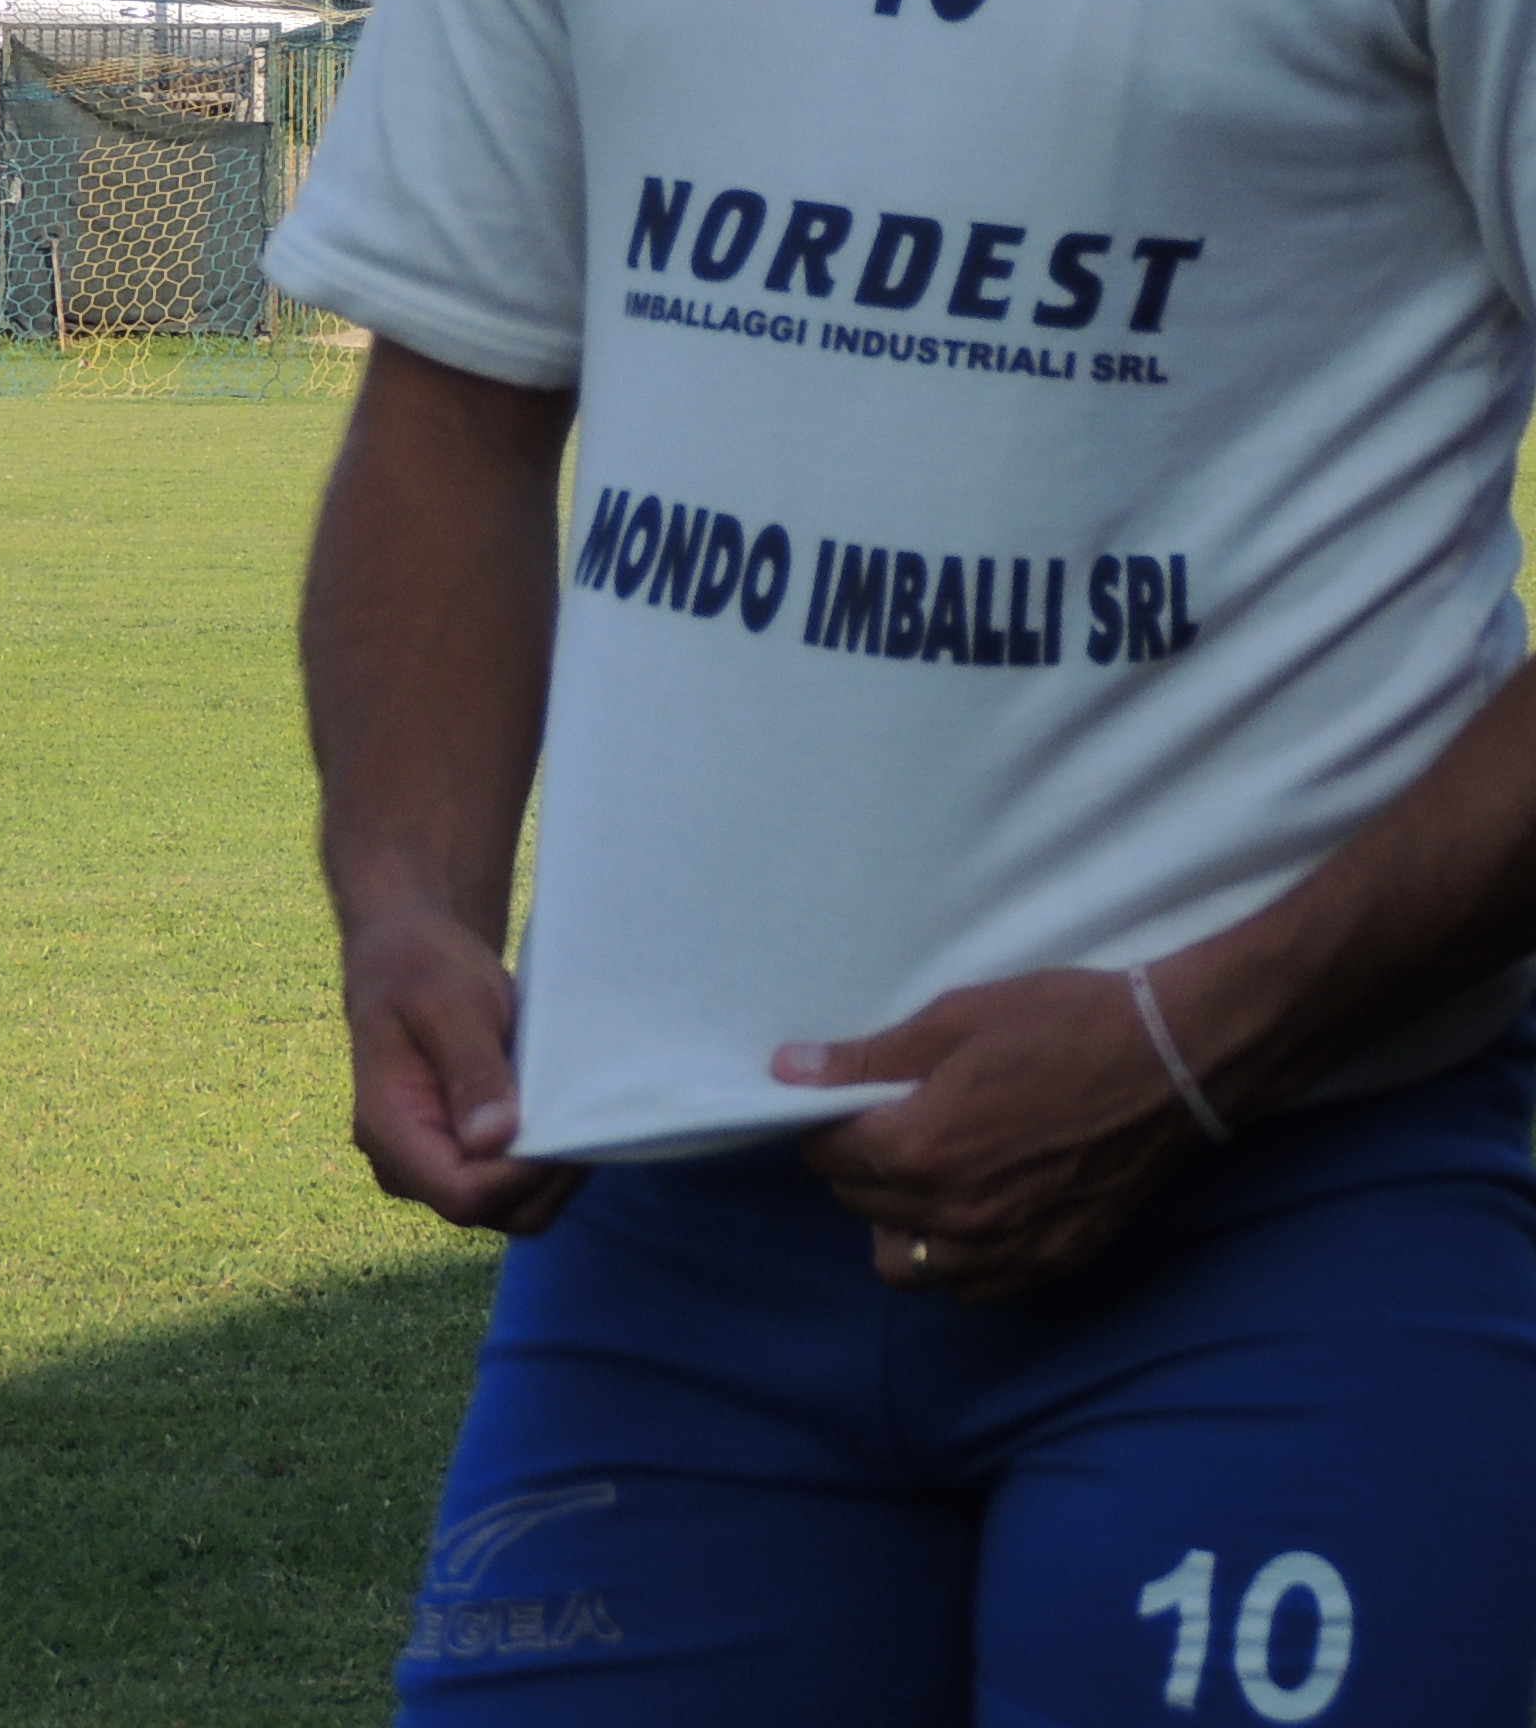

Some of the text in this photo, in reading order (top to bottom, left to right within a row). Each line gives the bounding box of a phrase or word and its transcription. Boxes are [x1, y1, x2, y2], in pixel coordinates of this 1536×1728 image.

[624, 290, 1169, 386] IMBALLAGGI INDUSTRIALI SRL
[626, 176, 1206, 334] NORDEST
[574, 487, 1202, 667] MONDO IMBALLI SRL
[1138, 1548, 1355, 1725] 10
